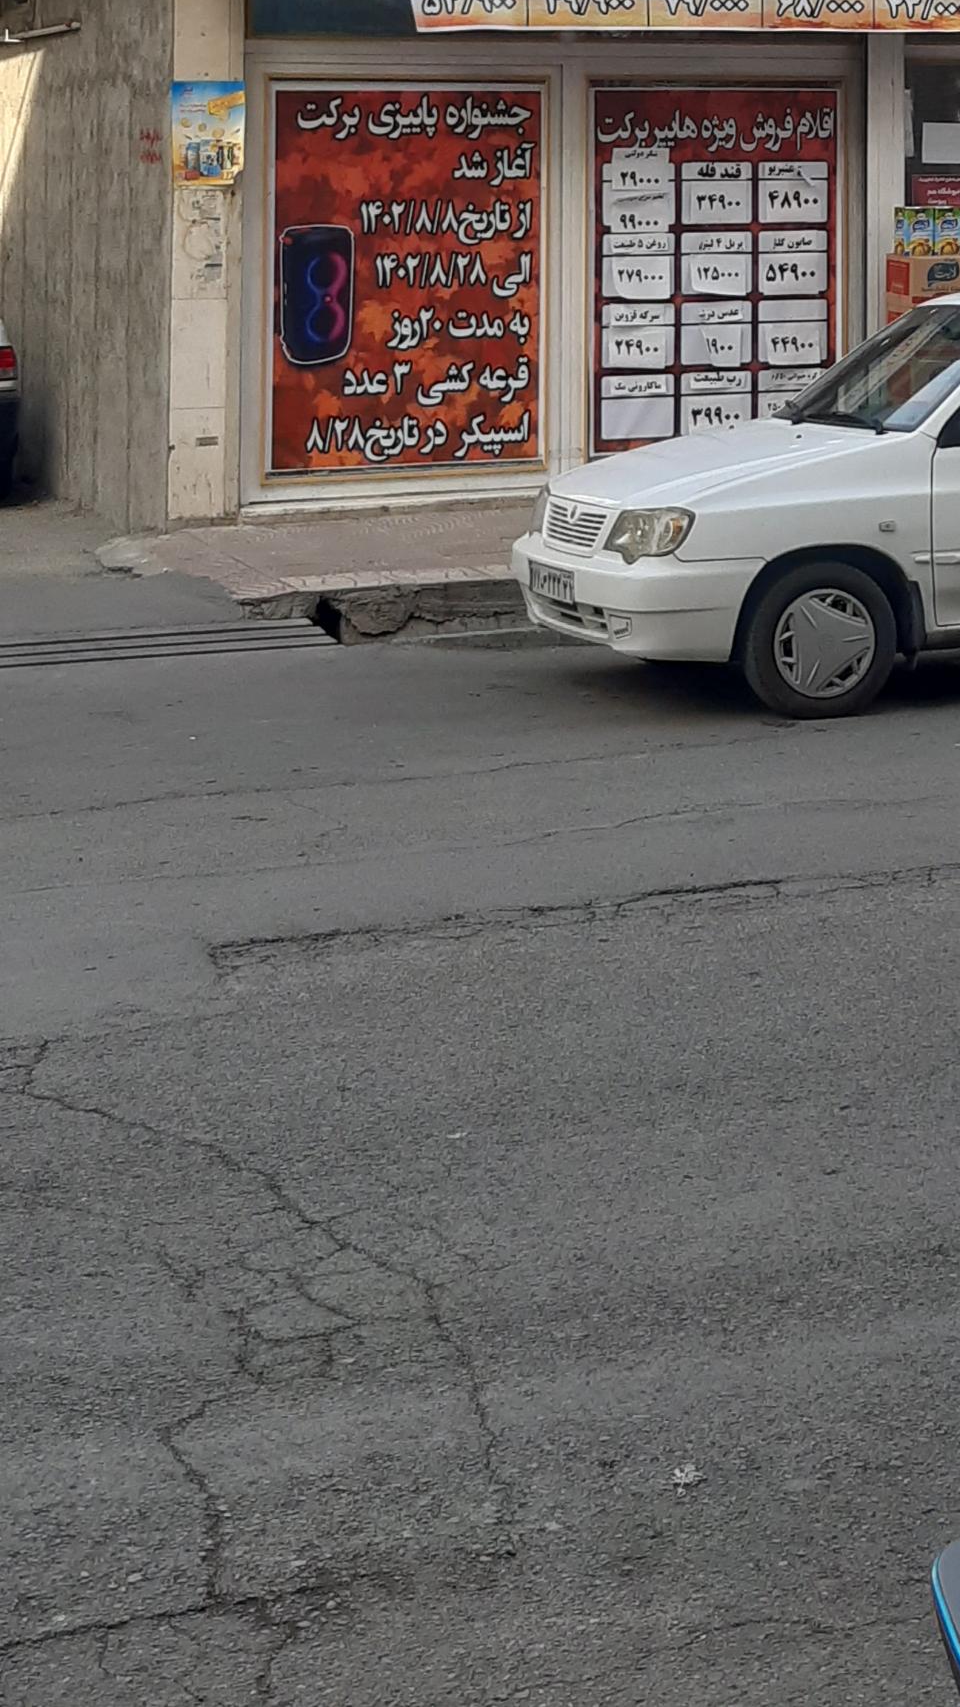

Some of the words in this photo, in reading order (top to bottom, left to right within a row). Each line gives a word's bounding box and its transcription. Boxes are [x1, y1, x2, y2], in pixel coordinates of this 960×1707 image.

[297, 97, 362, 139] برکت
[367, 95, 438, 139] پاییزی
[445, 97, 532, 139] جشنواره
[596, 111, 650, 148] برکت
[651, 109, 698, 147] هایپر
[739, 107, 794, 153] فروش
[796, 107, 834, 151] اقلام
[700, 114, 737, 152] ویژه
[453, 151, 488, 178] شد
[489, 142, 535, 186] آغاز
[620, 171, 660, 186] ۲۹۰۰۰
[697, 162, 717, 179] فله
[720, 165, 742, 179] قند
[696, 194, 741, 210] ۳۴۹۰۰
[768, 190, 819, 209] ۴۸۹۰۰
[512, 198, 532, 239] از
[619, 213, 659, 229] ۹۹۰۰۰
[787, 236, 813, 249] صابون
[375, 251, 488, 289] ۱۴۰۲/۸/۲۸
[491, 250, 532, 298] الی
[618, 268, 664, 283] ۲۷۹۰۰۰
[697, 266, 740, 280] ۱۲۵۰۰۰
[765, 262, 816, 282] ۵۴۹۰۰
[448, 310, 506, 339] مدت
[509, 309, 530, 346] به
[717, 308, 739, 320] عدس
[614, 338, 659, 355] ۲۴۹۰۰
[771, 336, 814, 353] ۴۴۹۰۰
[343, 368, 389, 396] عدد
[392, 360, 413, 396] ۳
[416, 360, 476, 407] کشی
[478, 355, 530, 403] قرعه
[693, 371, 725, 384] طبیعت
[726, 374, 742, 387] رب
[691, 406, 741, 426] ۳۹۹۰۰
[418, 418, 449, 455] در
[453, 410, 532, 458] اسپیکر
